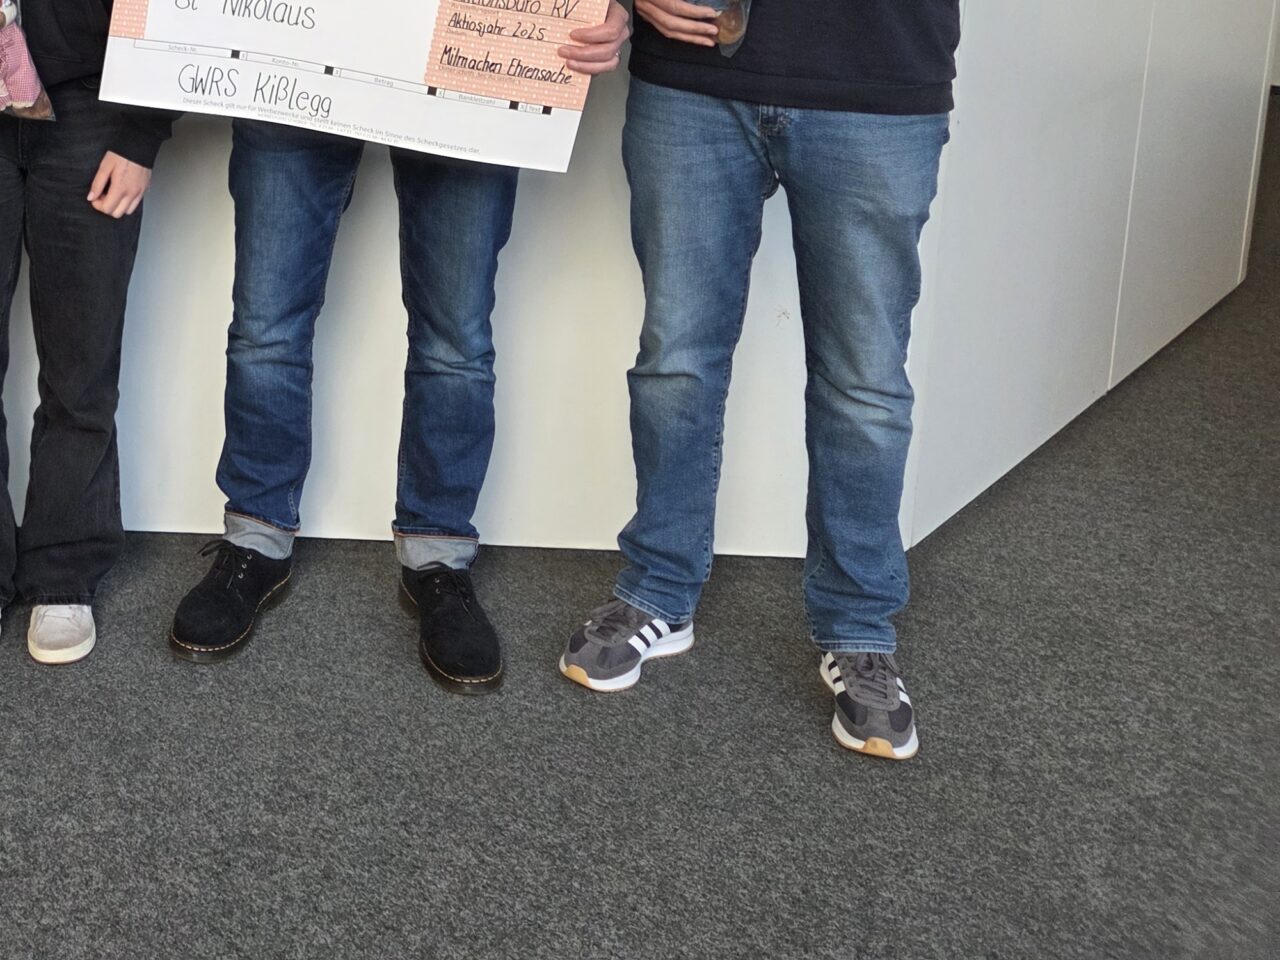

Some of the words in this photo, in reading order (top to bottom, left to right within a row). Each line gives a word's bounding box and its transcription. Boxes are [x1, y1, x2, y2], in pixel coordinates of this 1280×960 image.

[447, 12, 506, 37] Aktiosjahr
[512, 21, 547, 40] 2025
[506, 57, 573, 85] Ehrensache
[178, 63, 240, 98] GWRS
[253, 71, 333, 119] Kißlegg
